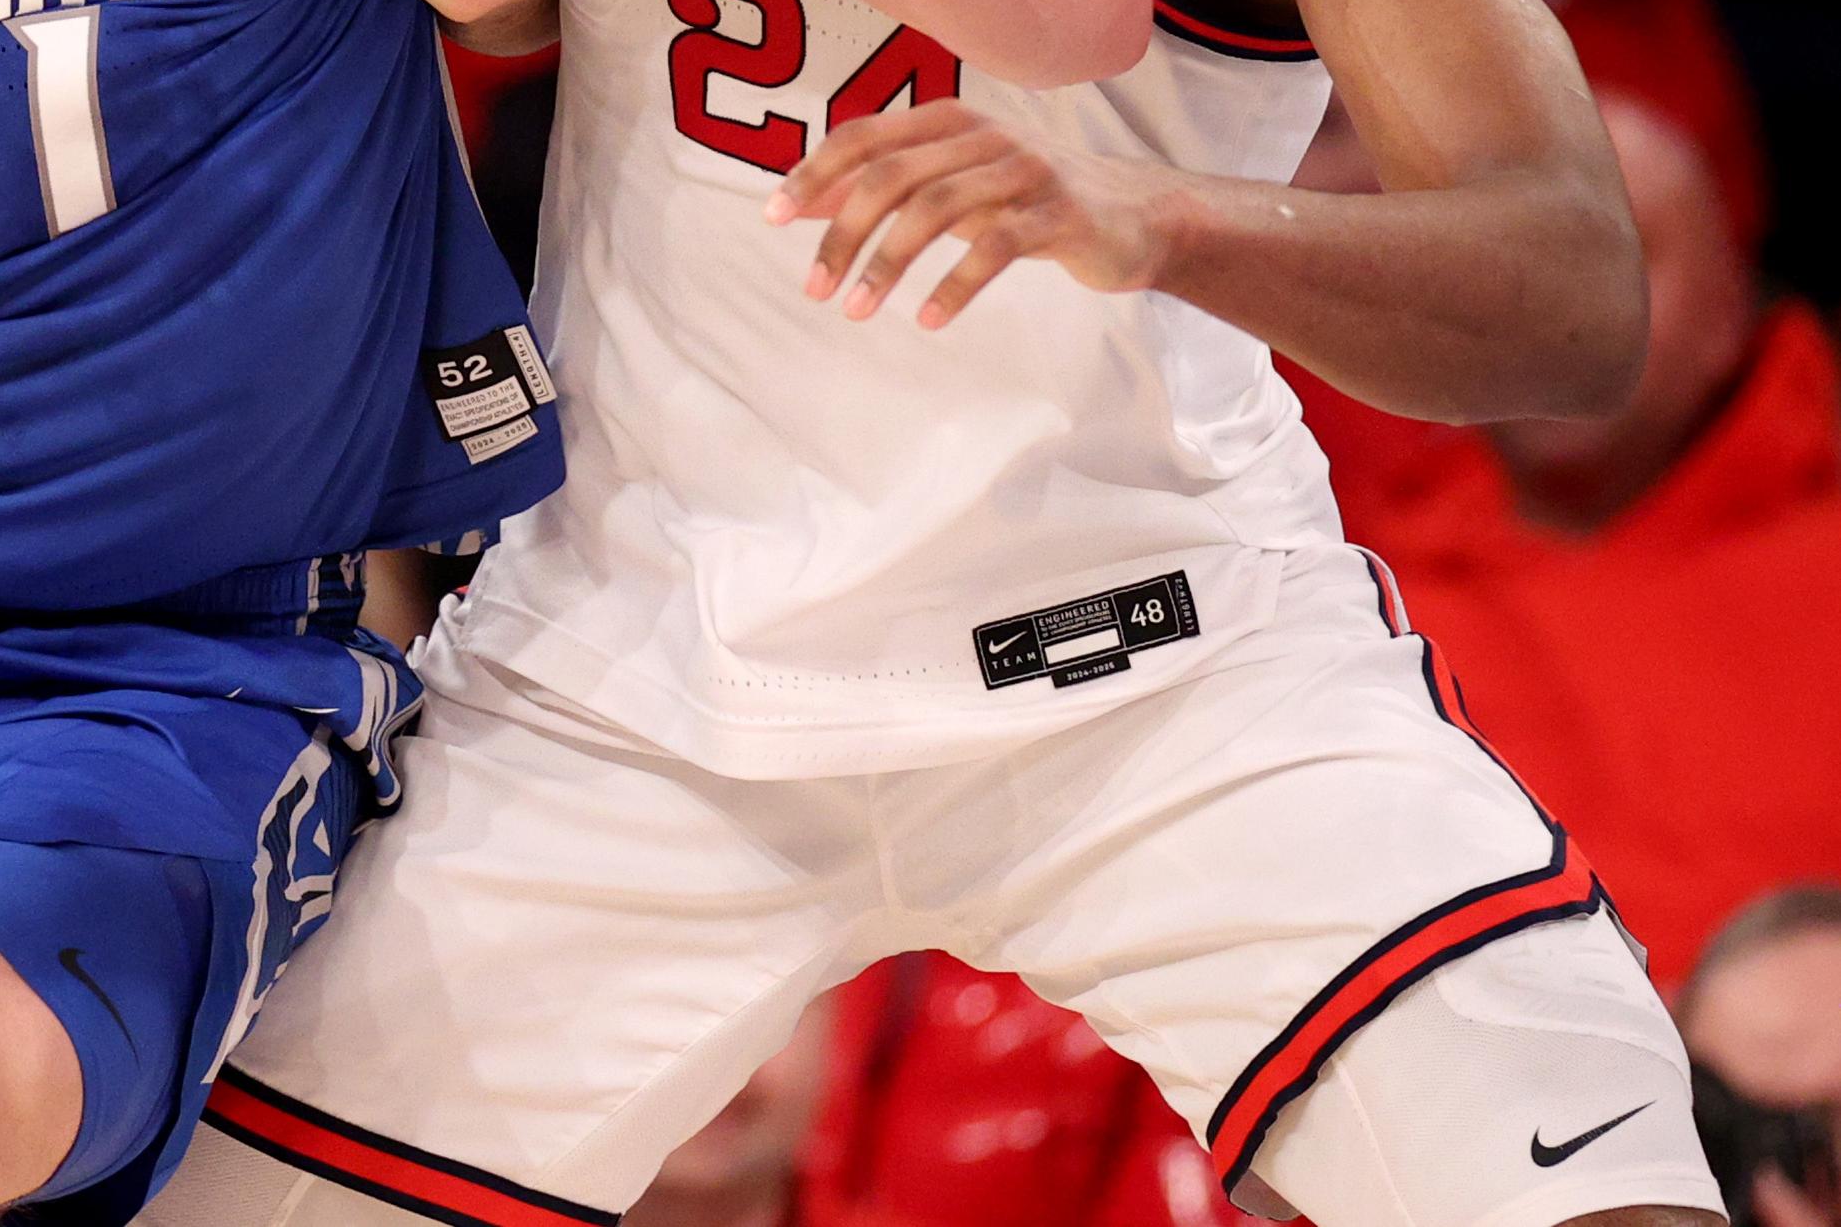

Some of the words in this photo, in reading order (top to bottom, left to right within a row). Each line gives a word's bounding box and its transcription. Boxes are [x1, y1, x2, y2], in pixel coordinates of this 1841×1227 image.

[437, 354, 493, 388] 52
[1039, 600, 1110, 627] ENGINEERED
[1130, 598, 1165, 627] 48
[992, 651, 1037, 670] TEAM
